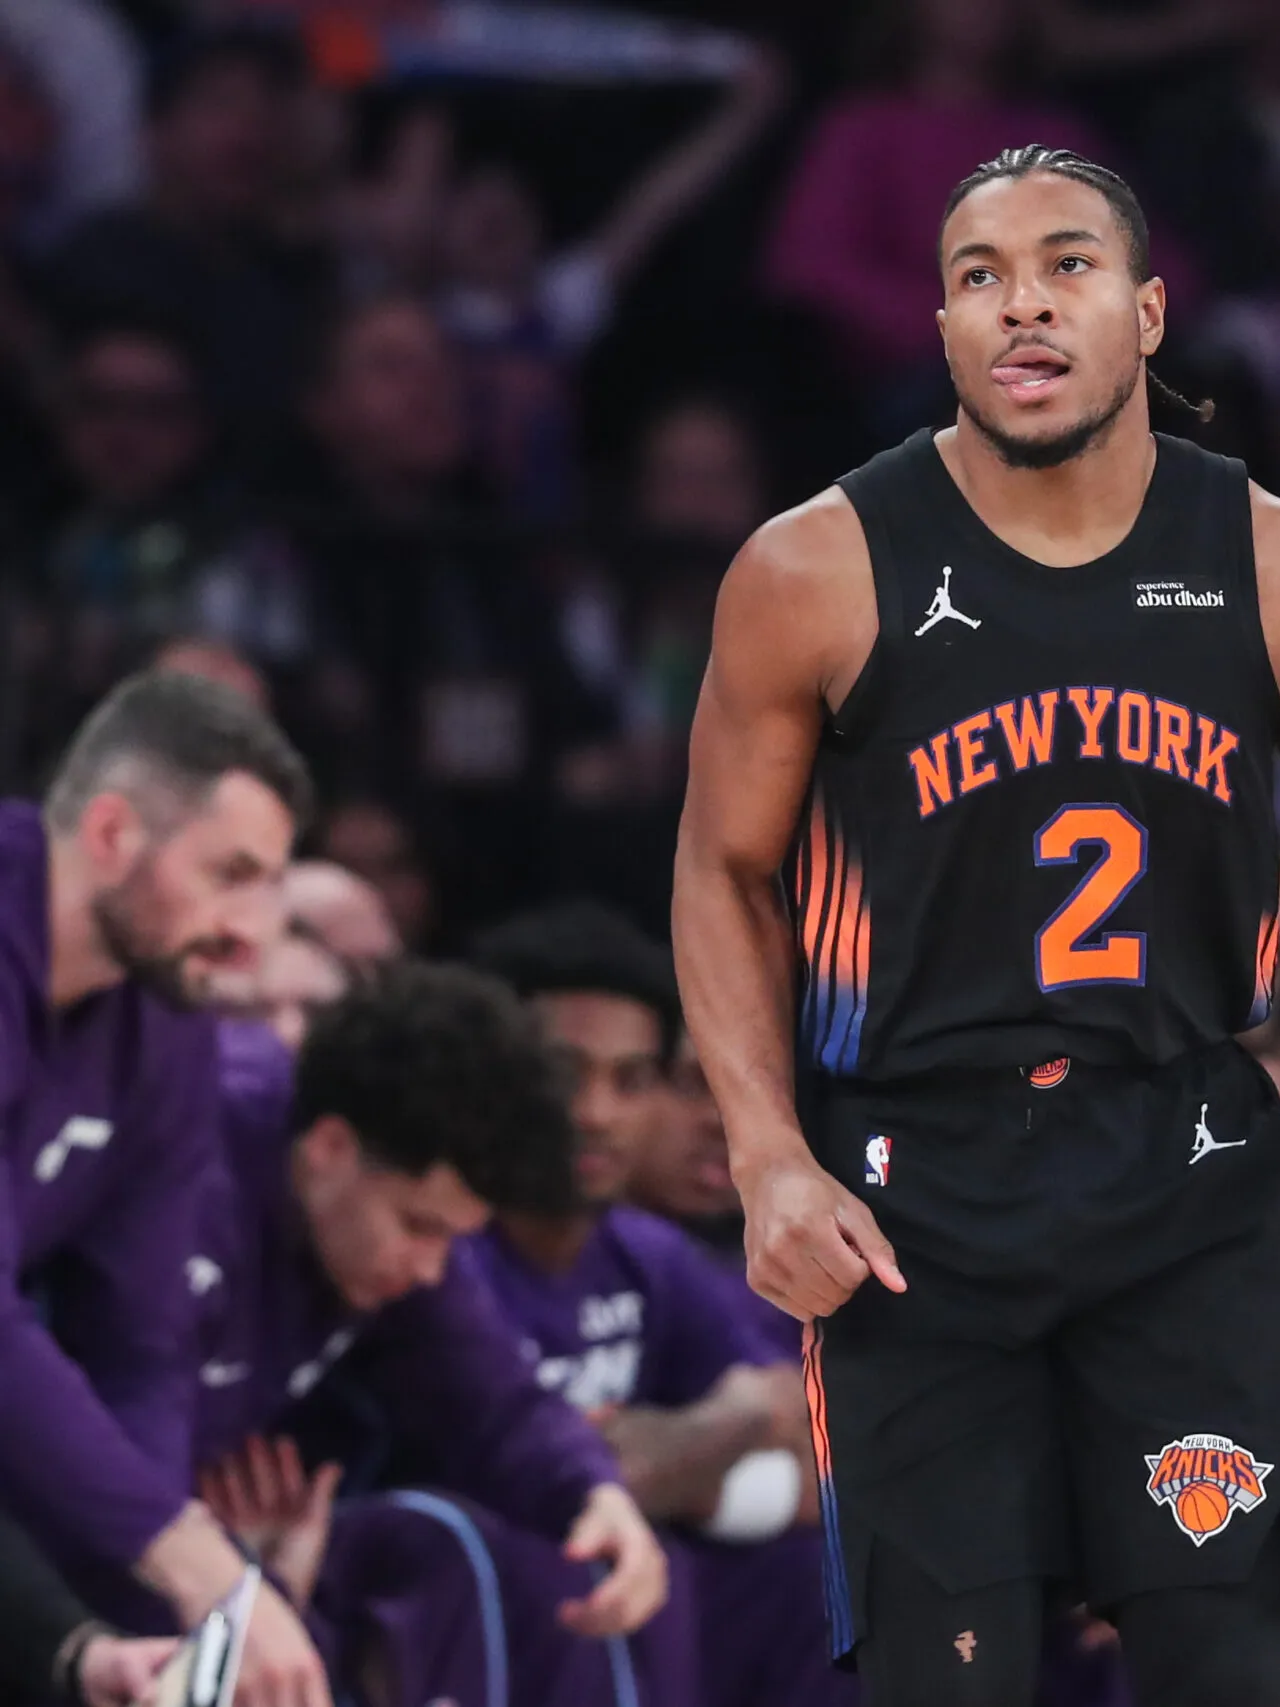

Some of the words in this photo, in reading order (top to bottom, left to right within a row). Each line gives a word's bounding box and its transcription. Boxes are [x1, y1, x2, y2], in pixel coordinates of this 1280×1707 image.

[1136, 581, 1184, 591] experience
[1136, 591, 1172, 607] abu
[1174, 590, 1225, 607] dhabi
[908, 687, 1060, 821] NEW
[1066, 685, 1240, 808] YORK
[1033, 802, 1149, 993] 2
[1183, 1437, 1205, 1449] NEW
[1206, 1437, 1231, 1451] YORK
[1150, 1447, 1263, 1499] KNICKS
